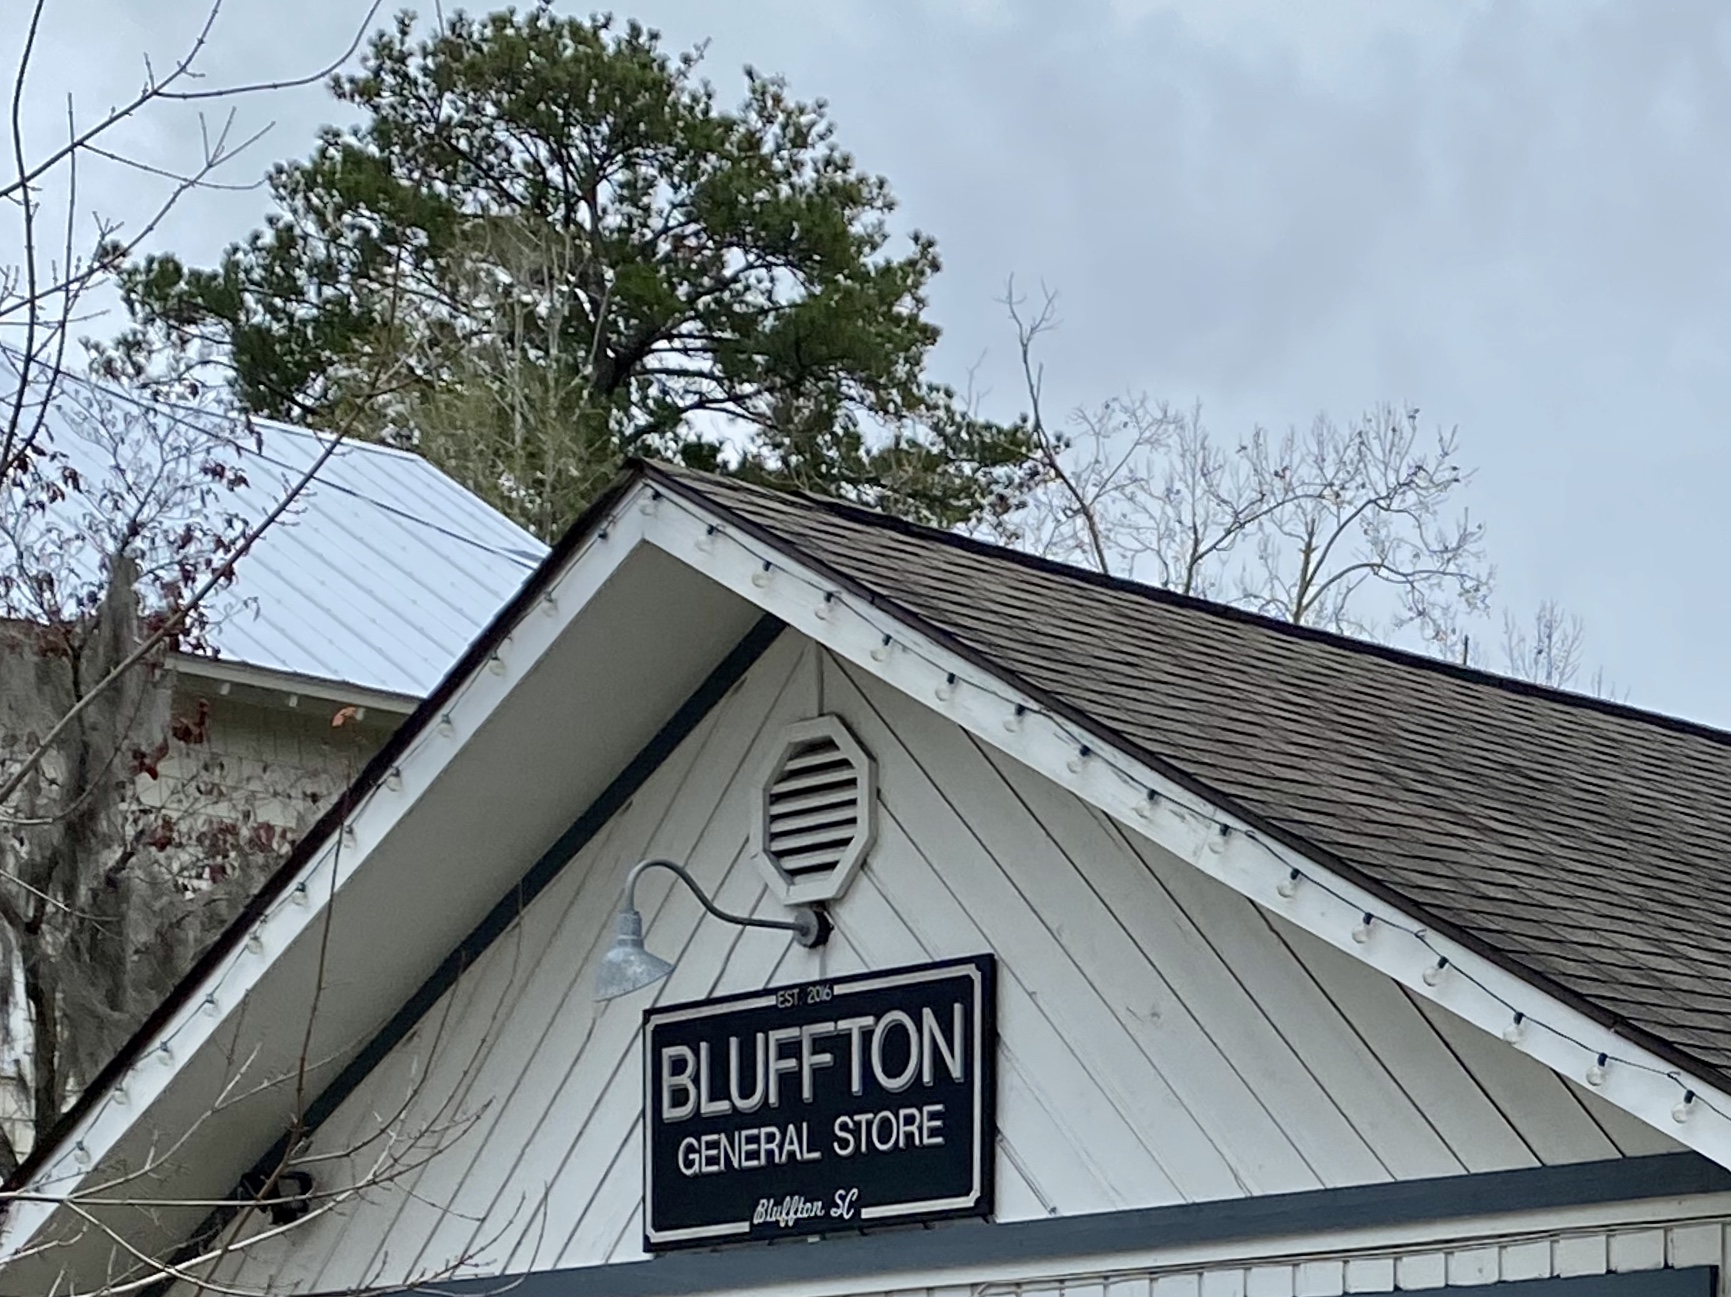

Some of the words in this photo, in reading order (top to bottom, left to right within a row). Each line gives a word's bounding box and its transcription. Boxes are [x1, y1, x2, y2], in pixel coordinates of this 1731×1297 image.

[661, 1002, 965, 1123] BLUFFTON
[678, 1121, 822, 1177] GENERAL
[833, 1104, 945, 1157] STORE
[753, 1195, 825, 1227] Bluffton
[830, 1188, 859, 1219] SC
